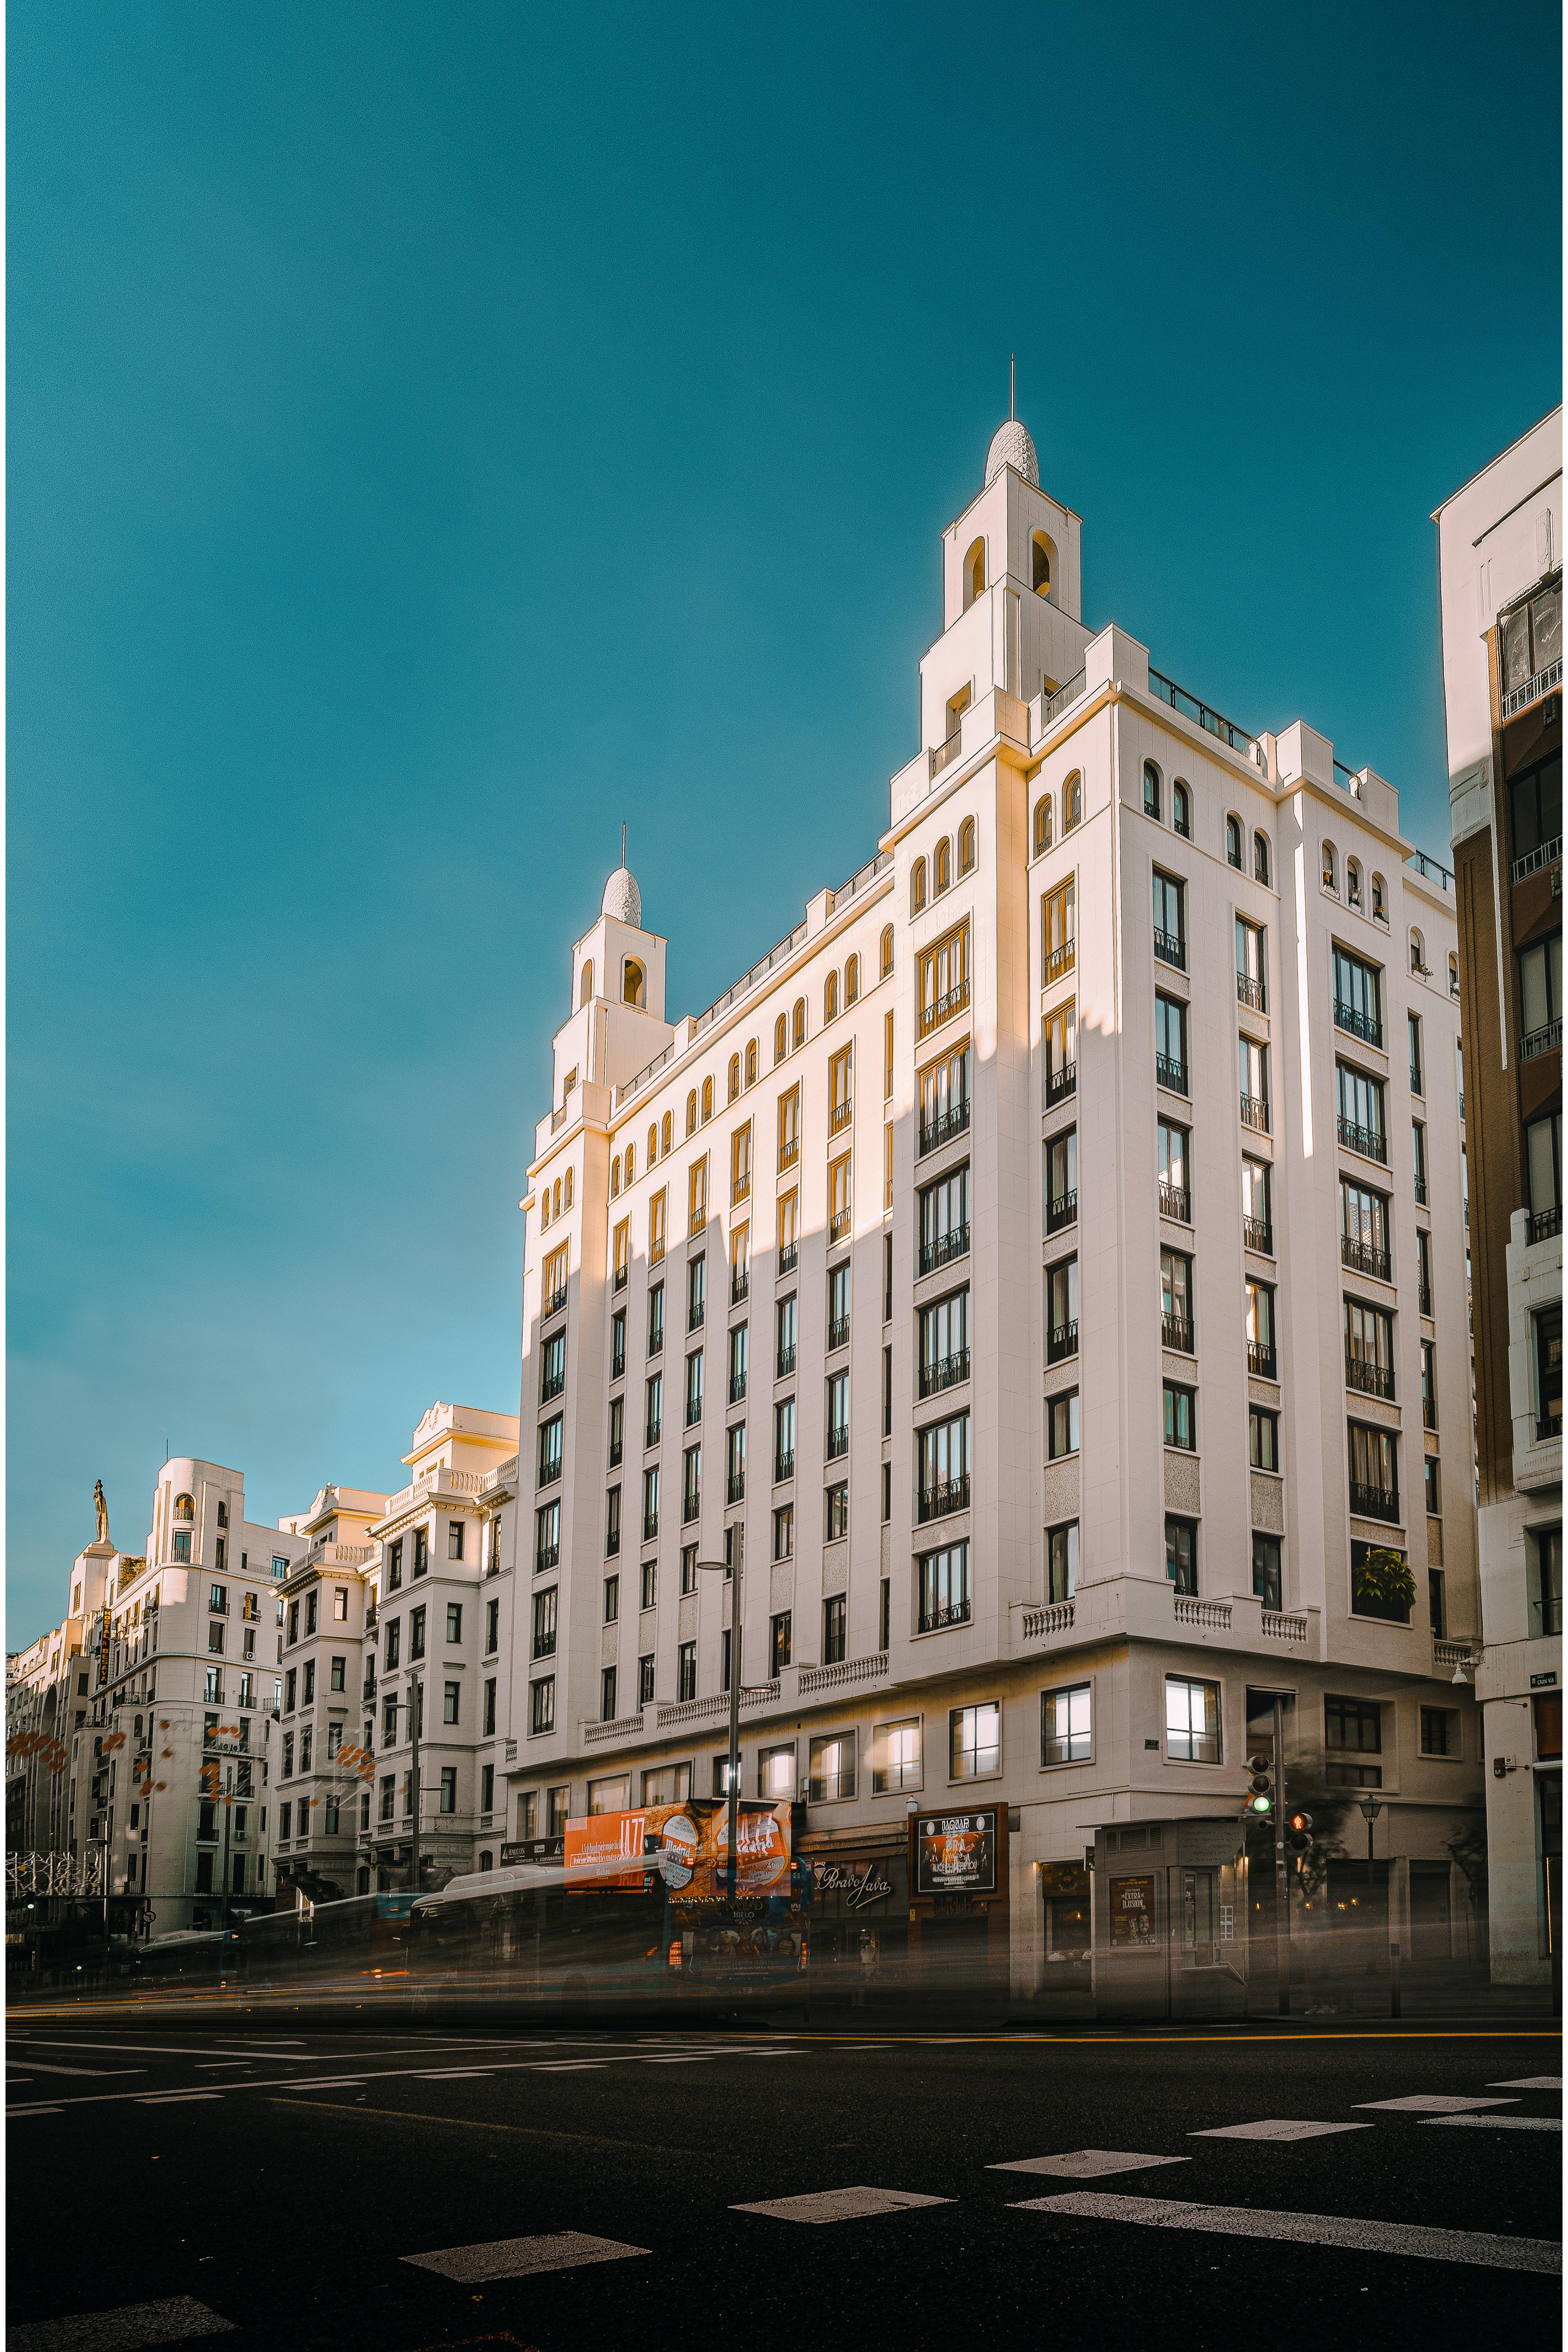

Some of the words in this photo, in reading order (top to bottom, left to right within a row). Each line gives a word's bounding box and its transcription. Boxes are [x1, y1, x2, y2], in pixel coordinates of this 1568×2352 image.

[666, 1838, 691, 1858] Madrid
[814, 1868, 860, 1889] Bravo
[847, 1864, 891, 1909] Java
[1125, 1892, 1140, 1900] EXTRA
[420, 1907, 437, 1917] 75
